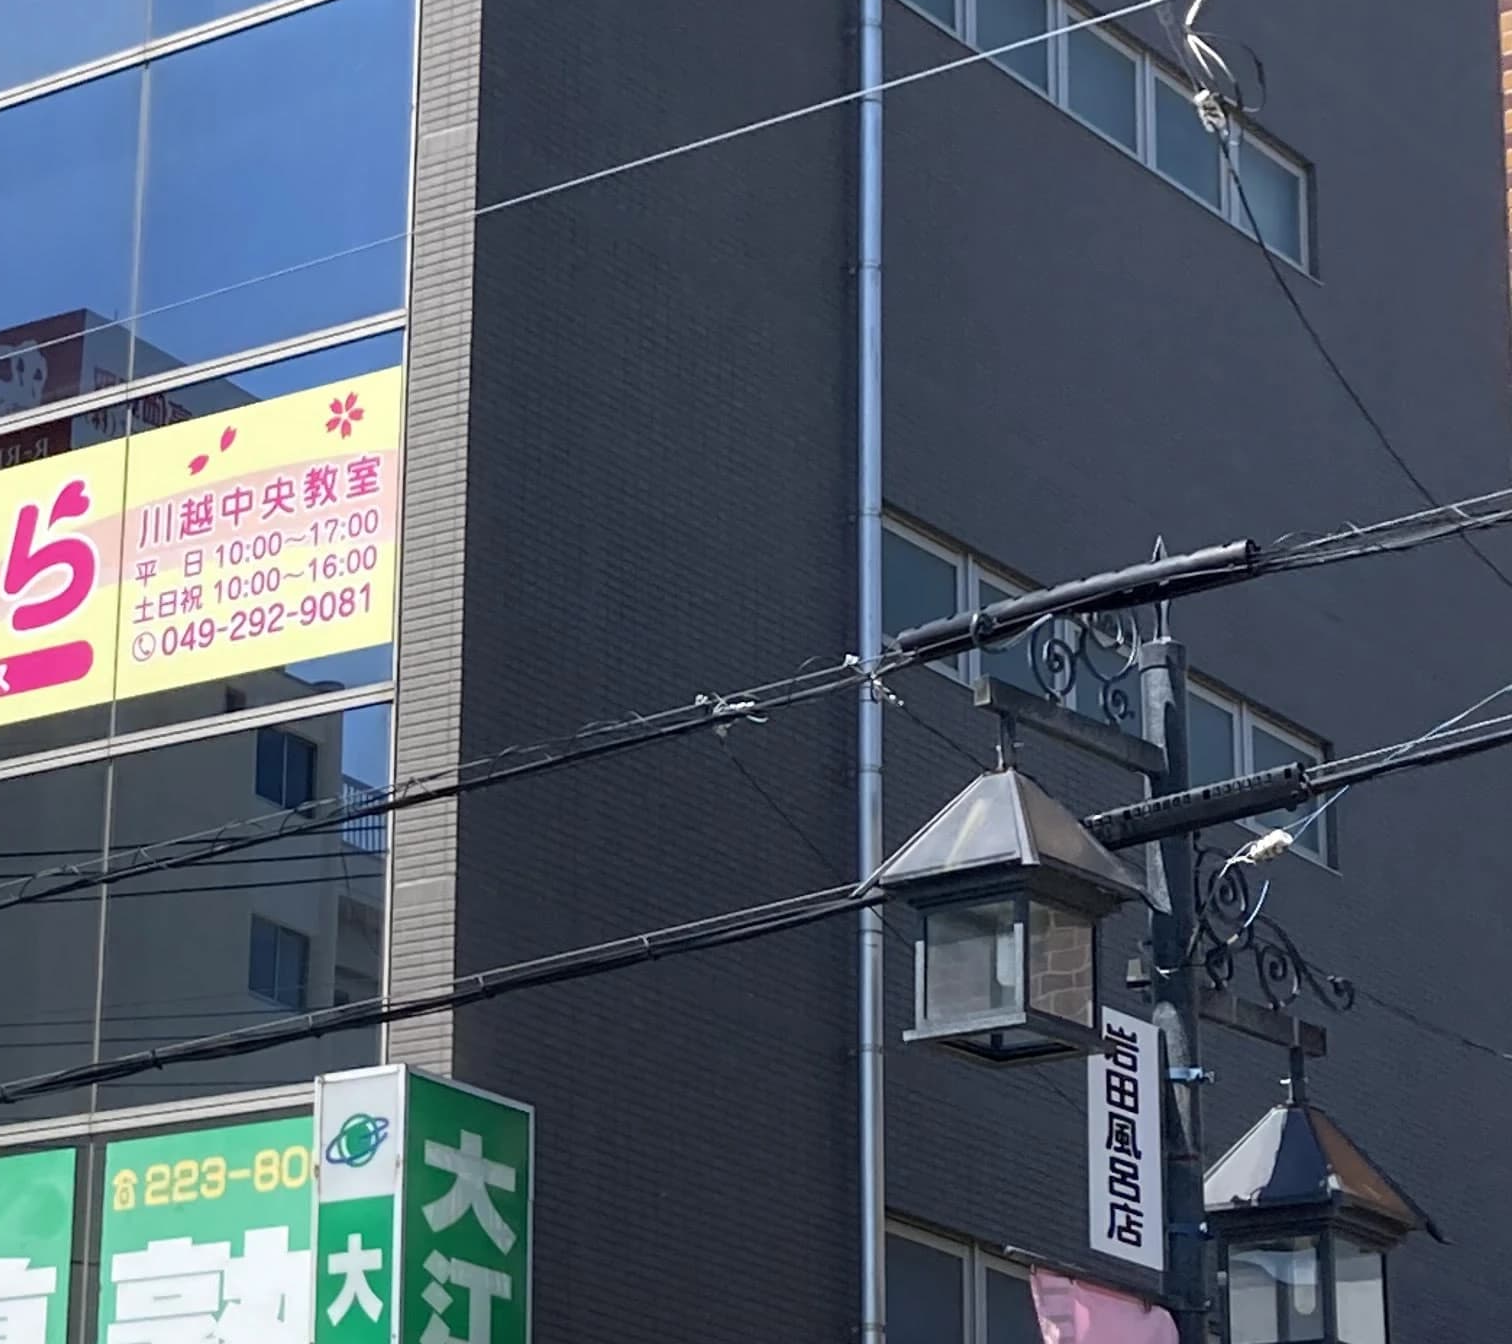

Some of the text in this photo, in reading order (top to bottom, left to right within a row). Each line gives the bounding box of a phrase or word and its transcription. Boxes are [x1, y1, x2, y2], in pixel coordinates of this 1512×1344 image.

[138, 455, 382, 548] 川越中央教室
[134, 584, 204, 624] 土日祝
[162, 583, 372, 657] 049-292-9081
[144, 1147, 312, 1207] 223-80
